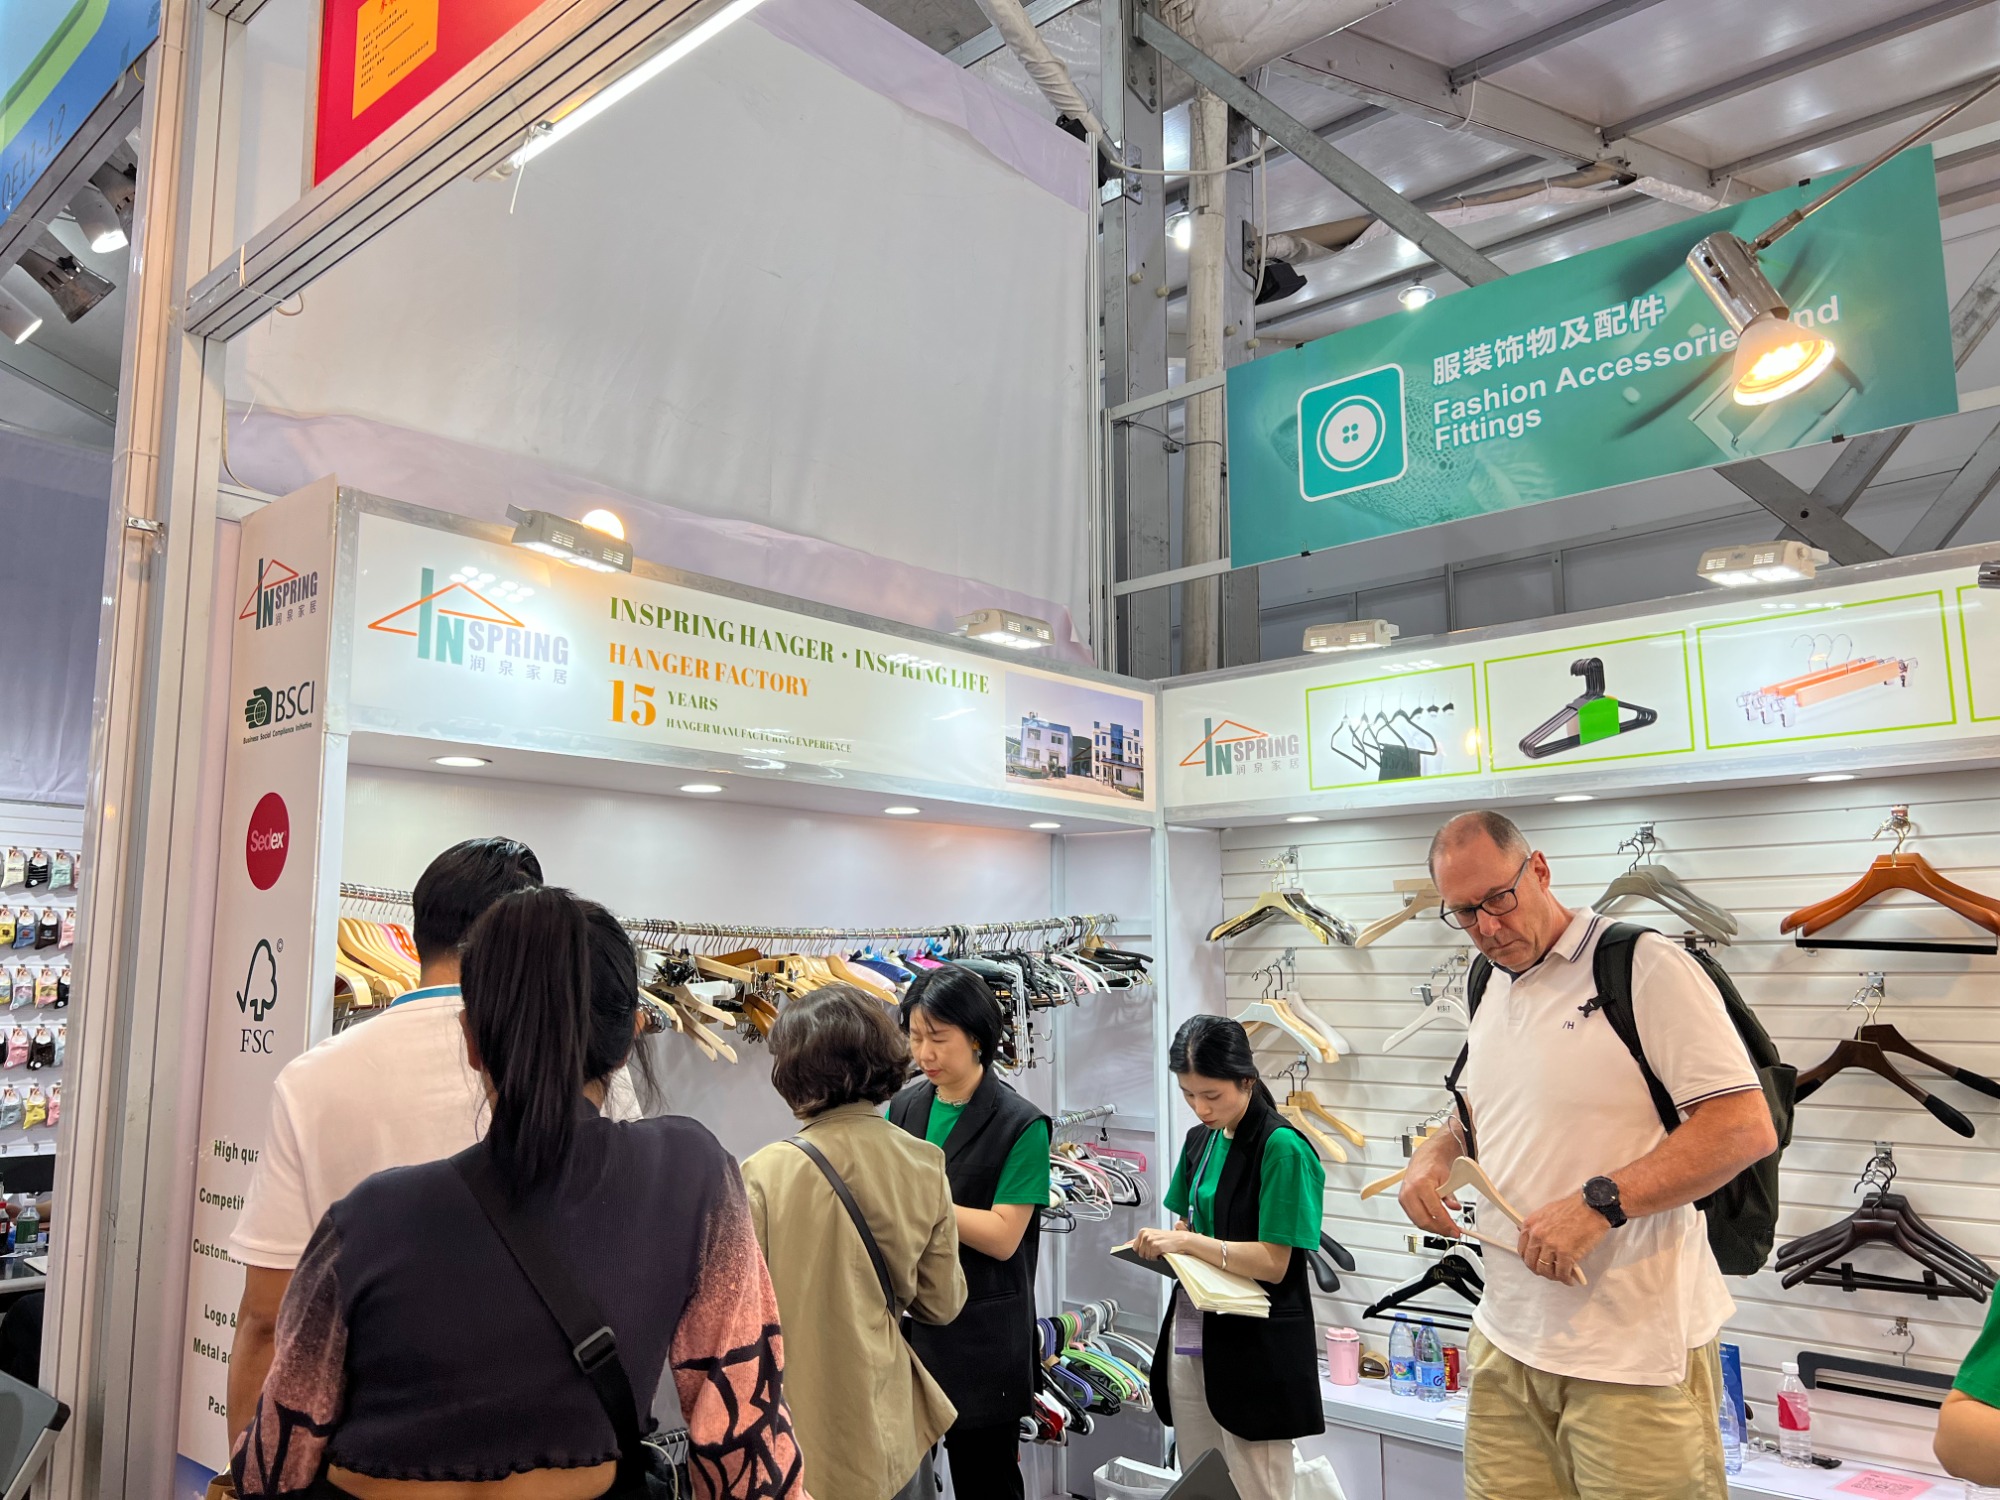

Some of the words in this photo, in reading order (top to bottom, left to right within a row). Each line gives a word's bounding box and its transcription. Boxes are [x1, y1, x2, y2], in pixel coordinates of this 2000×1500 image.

[1433, 294, 1664, 386] 服装饰物及配件
[1434, 379, 1547, 424] Fashion
[1555, 327, 1738, 393] Accessorie
[1793, 295, 1839, 329] nd
[1435, 408, 1542, 451] Fittings
[417, 567, 569, 666] INSPRING
[610, 596, 734, 643] INSPRING
[740, 623, 834, 664] HANGER
[855, 648, 947, 685] INSPRING
[951, 668, 989, 694] LIFE
[470, 654, 568, 685] 润泉家居
[609, 642, 709, 680] HANGER
[715, 661, 811, 697] FACTORY
[275, 680, 315, 722] BSCI
[607, 679, 657, 726] 15
[667, 690, 718, 711] YEARS
[666, 718, 710, 733] HANGER
[712, 725, 795, 745] MANUFACTURING
[796, 736, 853, 753] EXPERIENCE
[1204, 717, 1299, 776] INSPRING
[250, 828, 285, 852] Sedex
[240, 1029, 275, 1054] FSC
[214, 1140, 238, 1162] High
[204, 1303, 227, 1327] Logo
[193, 1337, 220, 1360] Metal
